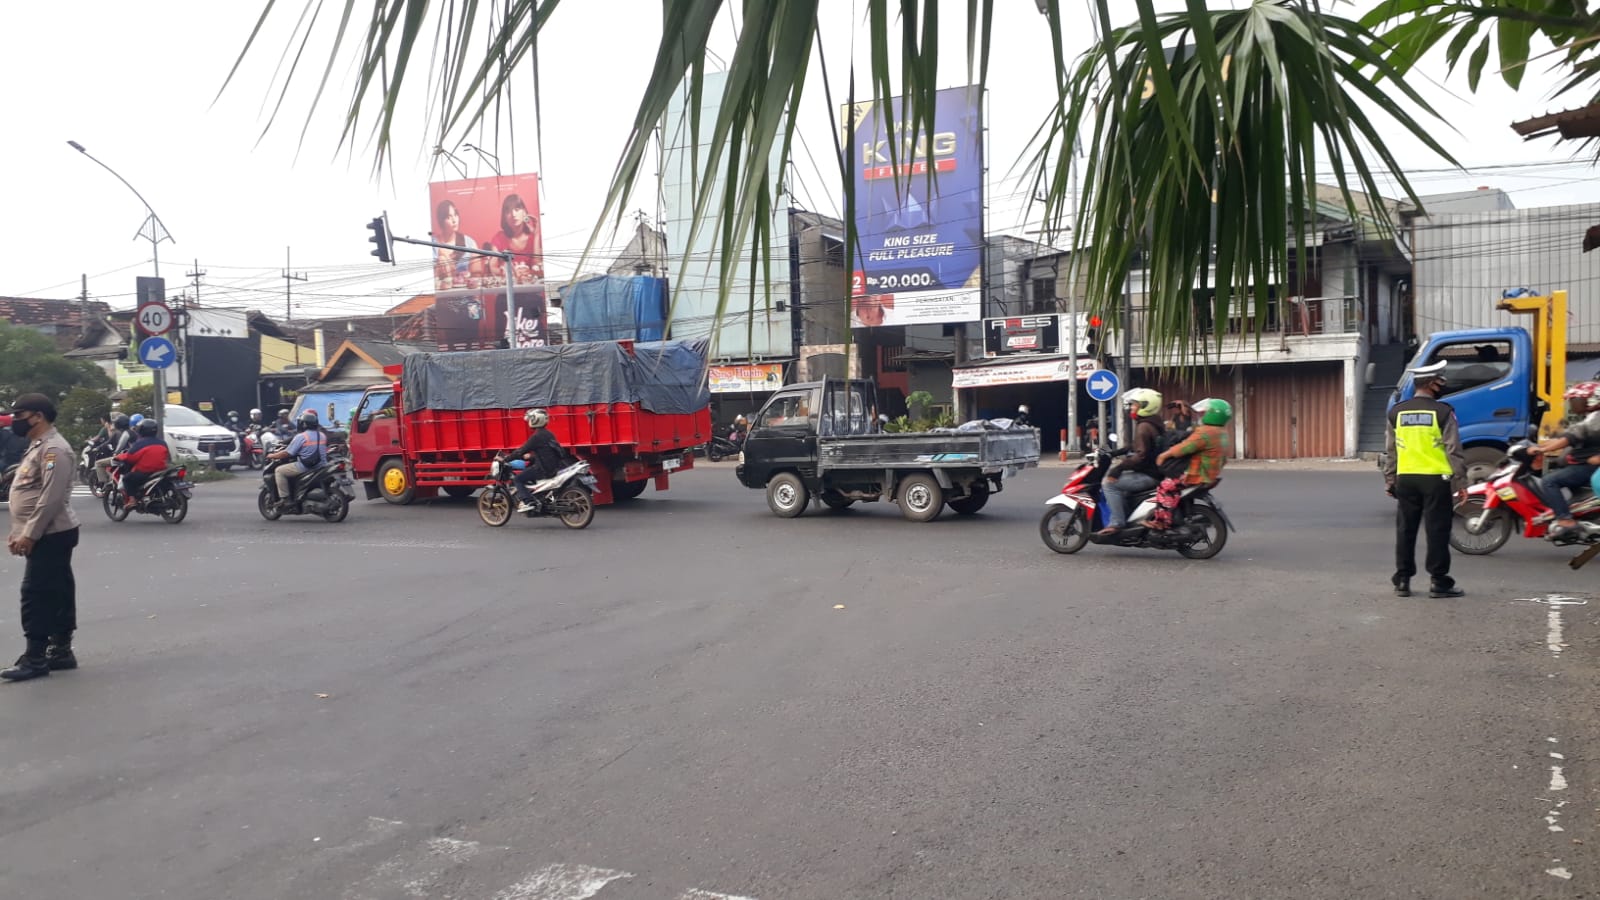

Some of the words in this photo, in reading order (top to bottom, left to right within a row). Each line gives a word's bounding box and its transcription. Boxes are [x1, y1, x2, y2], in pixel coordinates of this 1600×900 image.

[884, 236, 910, 247] KING
[913, 234, 938, 245] SIZE
[869, 249, 895, 261] FULL
[897, 245, 954, 260] PLEASURE
[142, 312, 162, 326] 40
[991, 317, 1052, 330] ARES
